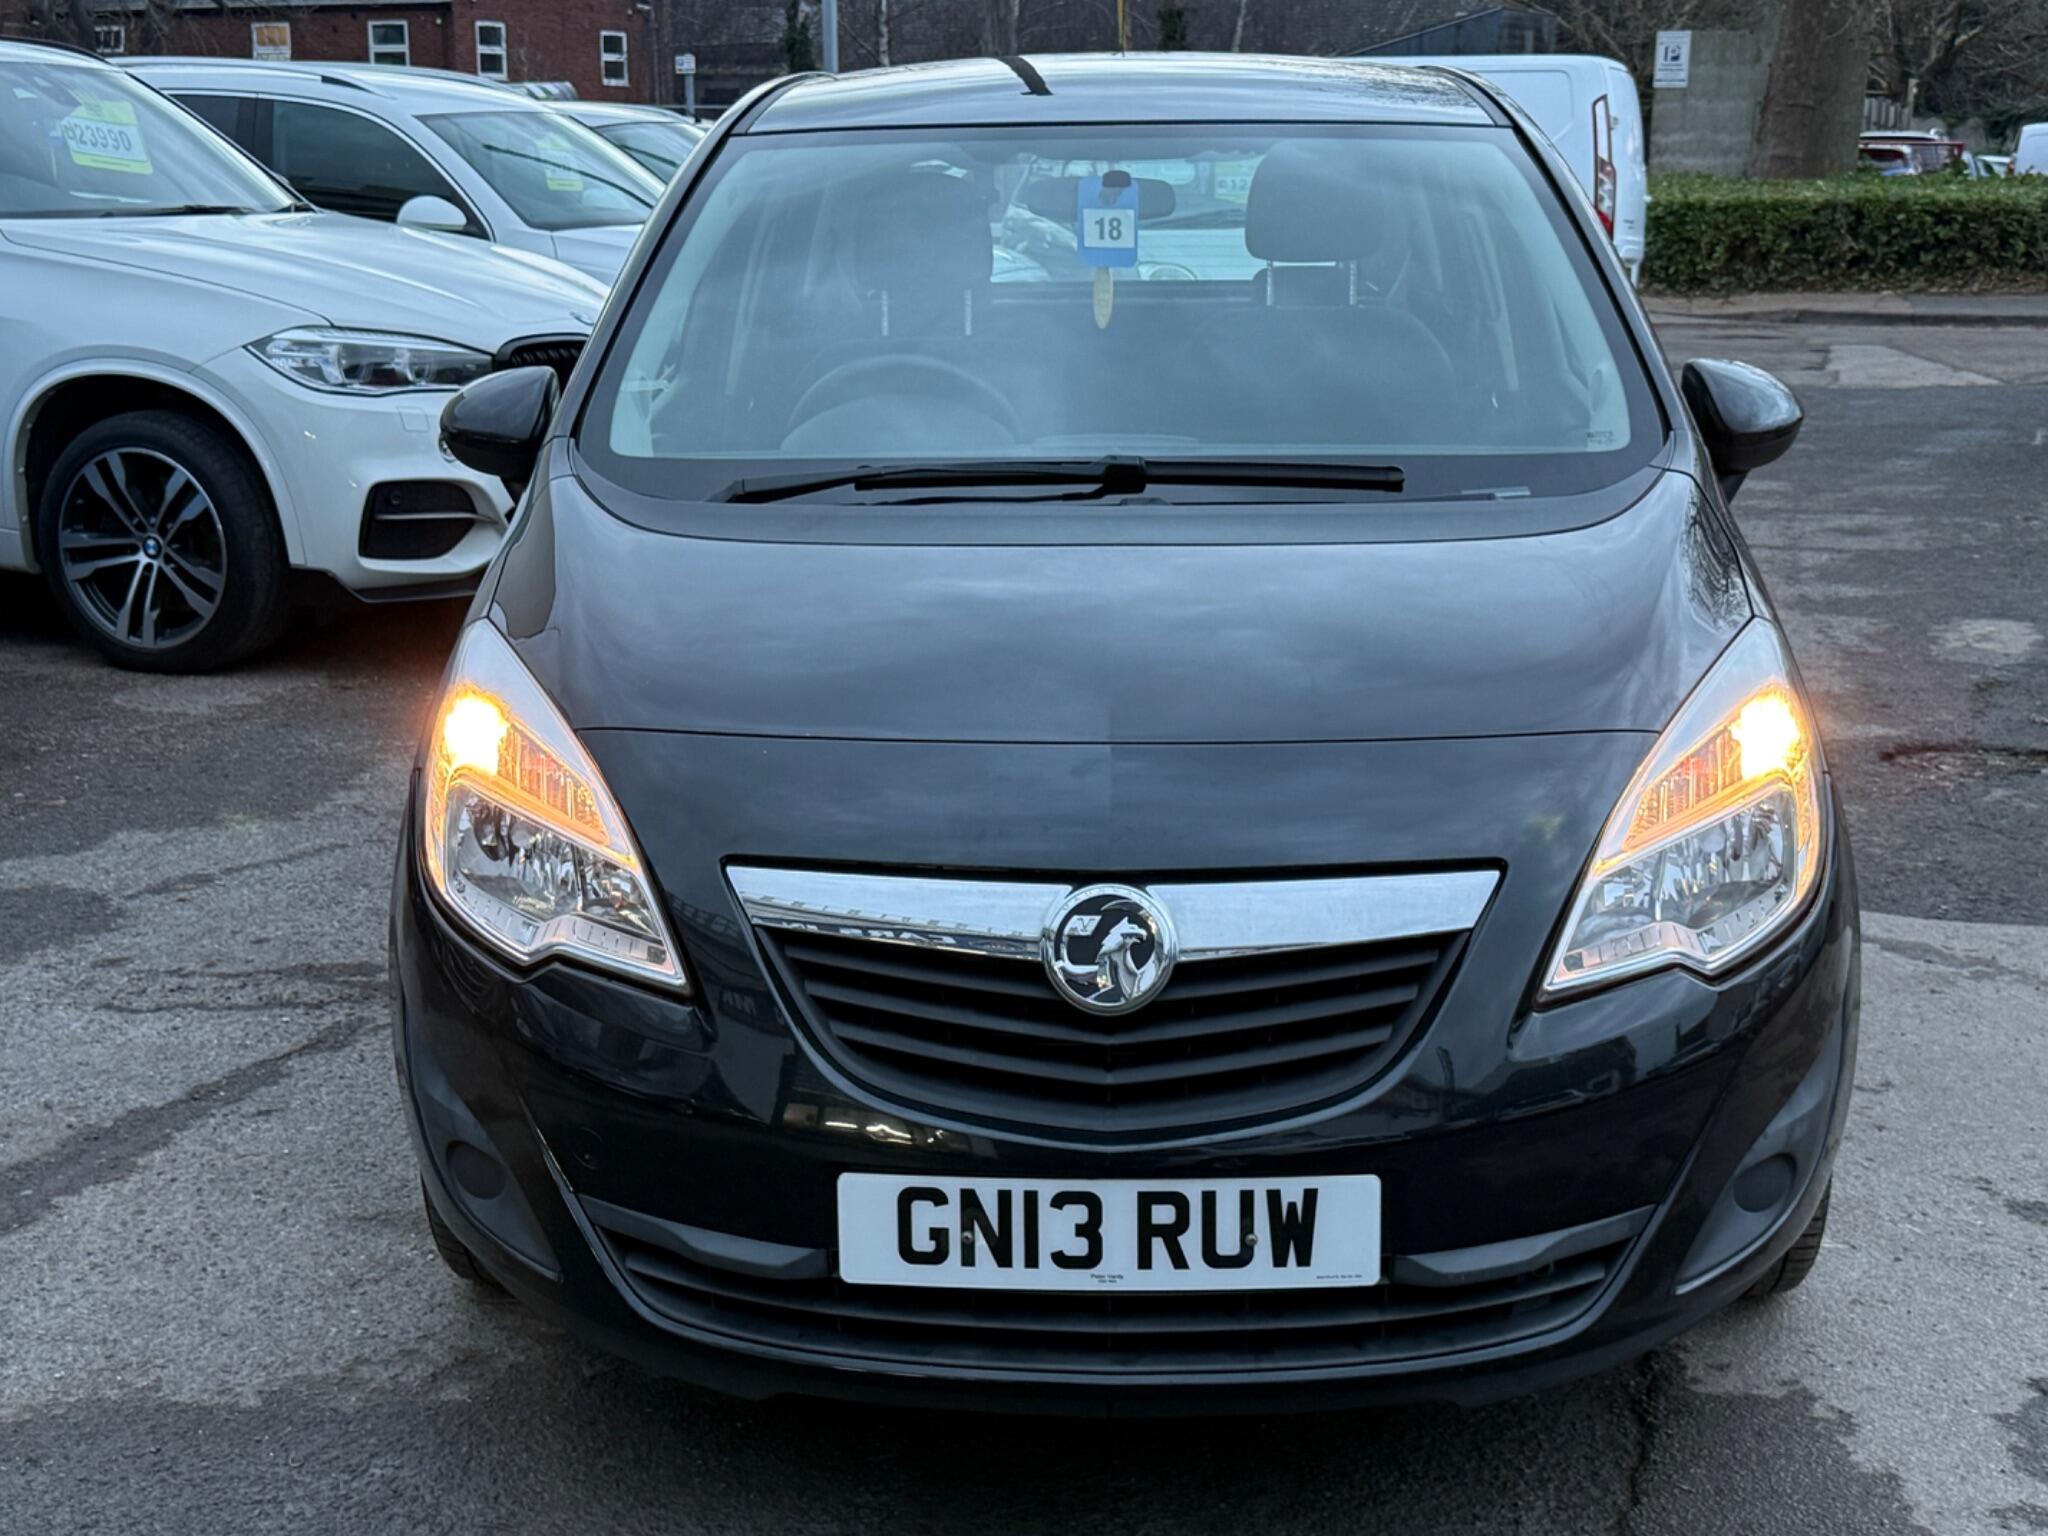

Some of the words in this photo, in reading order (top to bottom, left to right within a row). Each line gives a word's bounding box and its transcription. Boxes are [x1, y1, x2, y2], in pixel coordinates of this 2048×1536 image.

[1094, 217, 1122, 241] 18
[897, 1186, 1103, 1270] GN13
[1137, 1188, 1319, 1270] RUW
